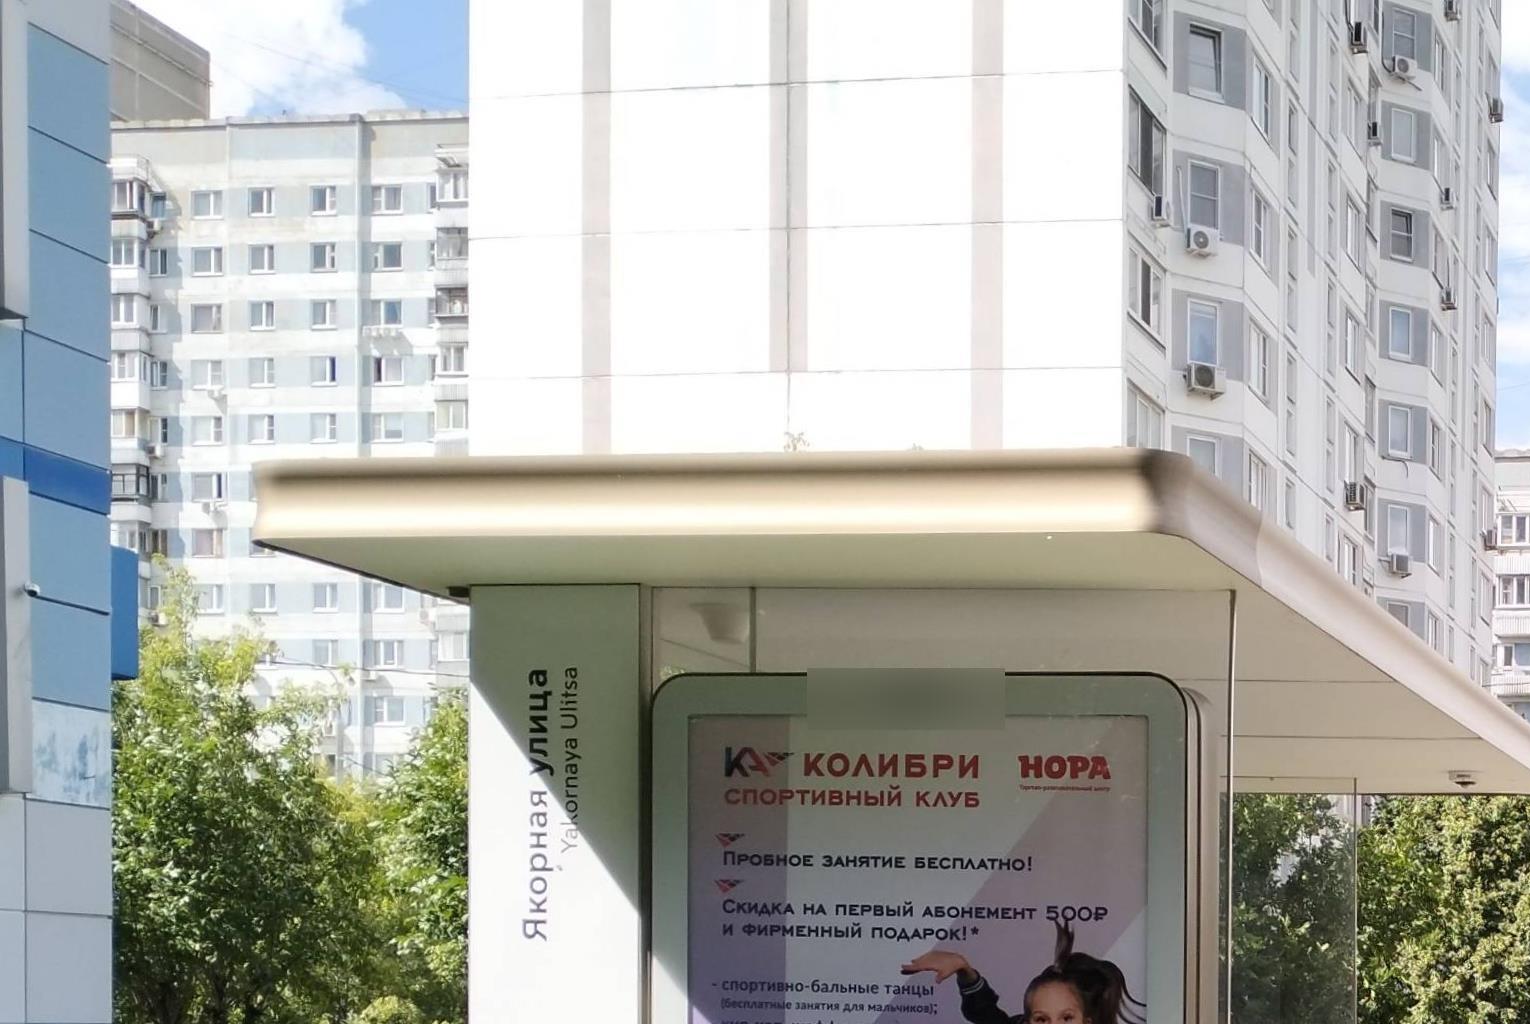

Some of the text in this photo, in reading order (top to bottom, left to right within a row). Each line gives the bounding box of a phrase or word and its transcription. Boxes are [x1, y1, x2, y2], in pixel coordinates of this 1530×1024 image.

[560, 667, 582, 853] Yakornaya Ulitsa
[803, 752, 980, 779] КОЛИБРИ
[1017, 755, 1111, 780] НОРА
[522, 668, 554, 941] Якорная улица
[724, 784, 980, 808] СПОРТИВНЫЙ КЛУБ
[822, 855, 906, 869] ЗАНЯТИЕ
[914, 856, 1032, 871] БЕСПЛАТНО!
[803, 903, 827, 915] НА
[835, 901, 914, 917] ПЕРВЫЙ
[922, 905, 1037, 920] АБОНЕМЕНТ
[722, 923, 733, 936] И
[742, 922, 862, 938] ФИРМЕННЫЙ
[721, 980, 934, 998] спортивно-бальные танцы
[720, 998, 792, 1010] (бесплатные
[795, 1001, 840, 1011] занятия
[843, 1003, 864, 1013] для
